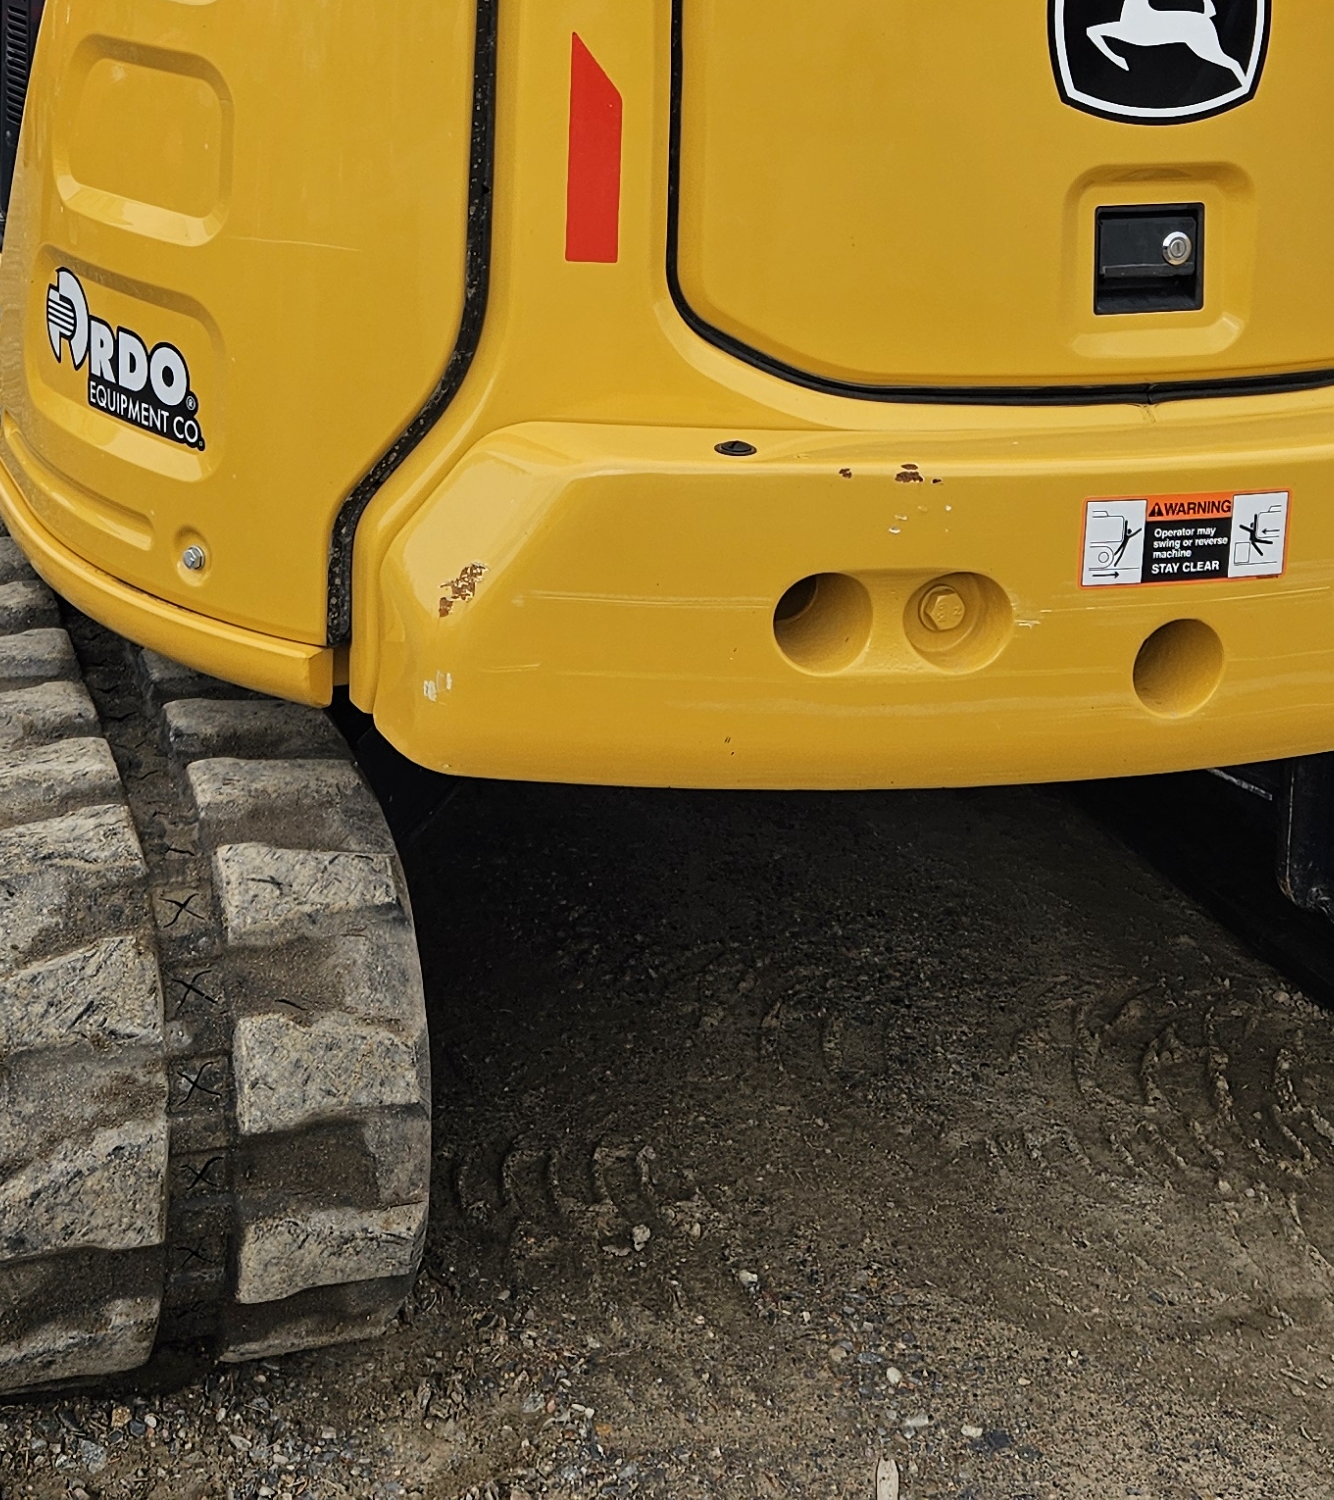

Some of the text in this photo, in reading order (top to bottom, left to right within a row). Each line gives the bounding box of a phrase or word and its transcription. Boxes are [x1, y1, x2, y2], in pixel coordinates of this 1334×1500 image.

[89, 380, 204, 447] EQUIPMENT CO.
[1164, 500, 1232, 517] WARNING
[1154, 527, 1217, 539] Operator may
[1153, 538, 1181, 549] swing
[1194, 537, 1228, 546] reverse
[1152, 549, 1192, 559] machine
[1151, 560, 1220, 575] STAY CLEAR
